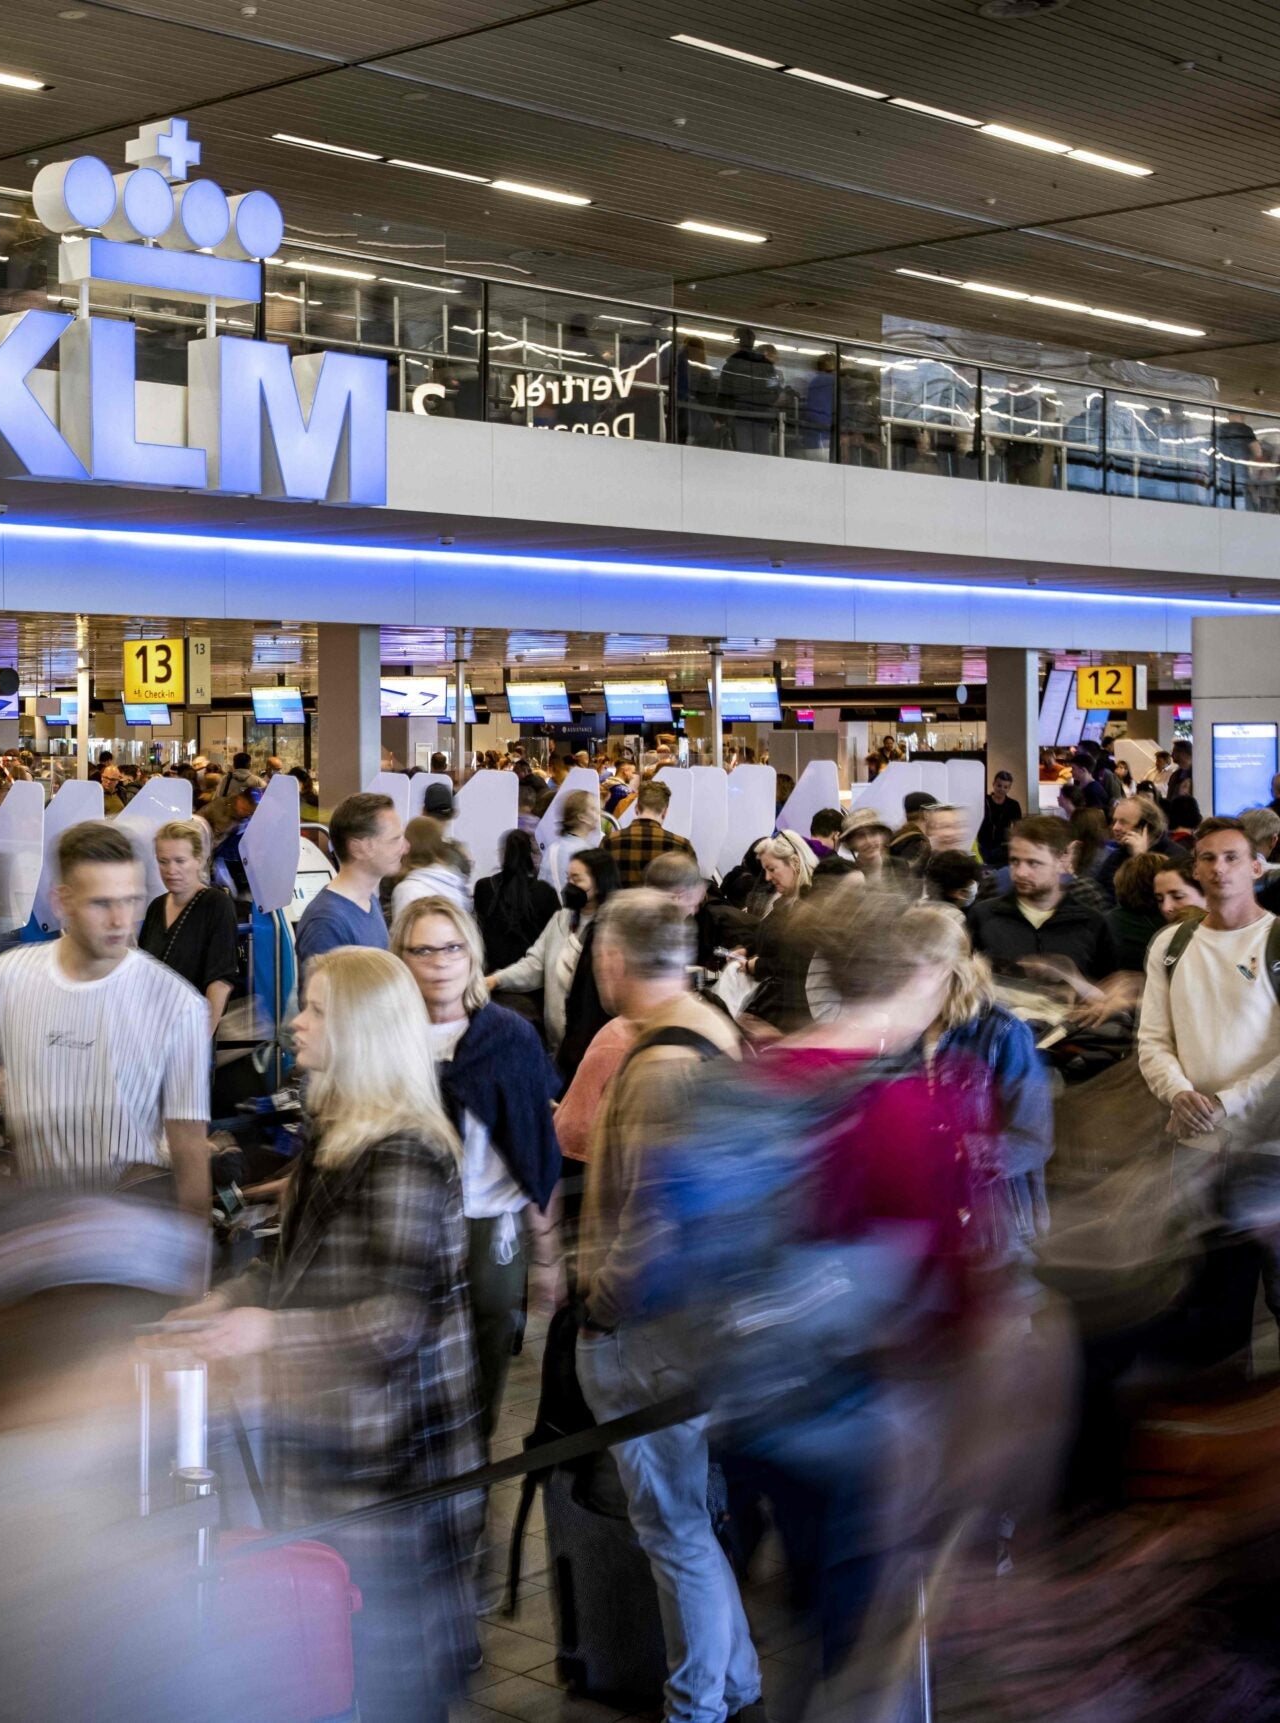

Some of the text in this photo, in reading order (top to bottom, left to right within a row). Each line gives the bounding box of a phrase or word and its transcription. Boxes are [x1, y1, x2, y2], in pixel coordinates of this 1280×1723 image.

[194, 643, 206, 655] 13
[135, 644, 173, 684] 13
[1088, 669, 1122, 695] 12
[144, 689, 175, 699] Check-in
